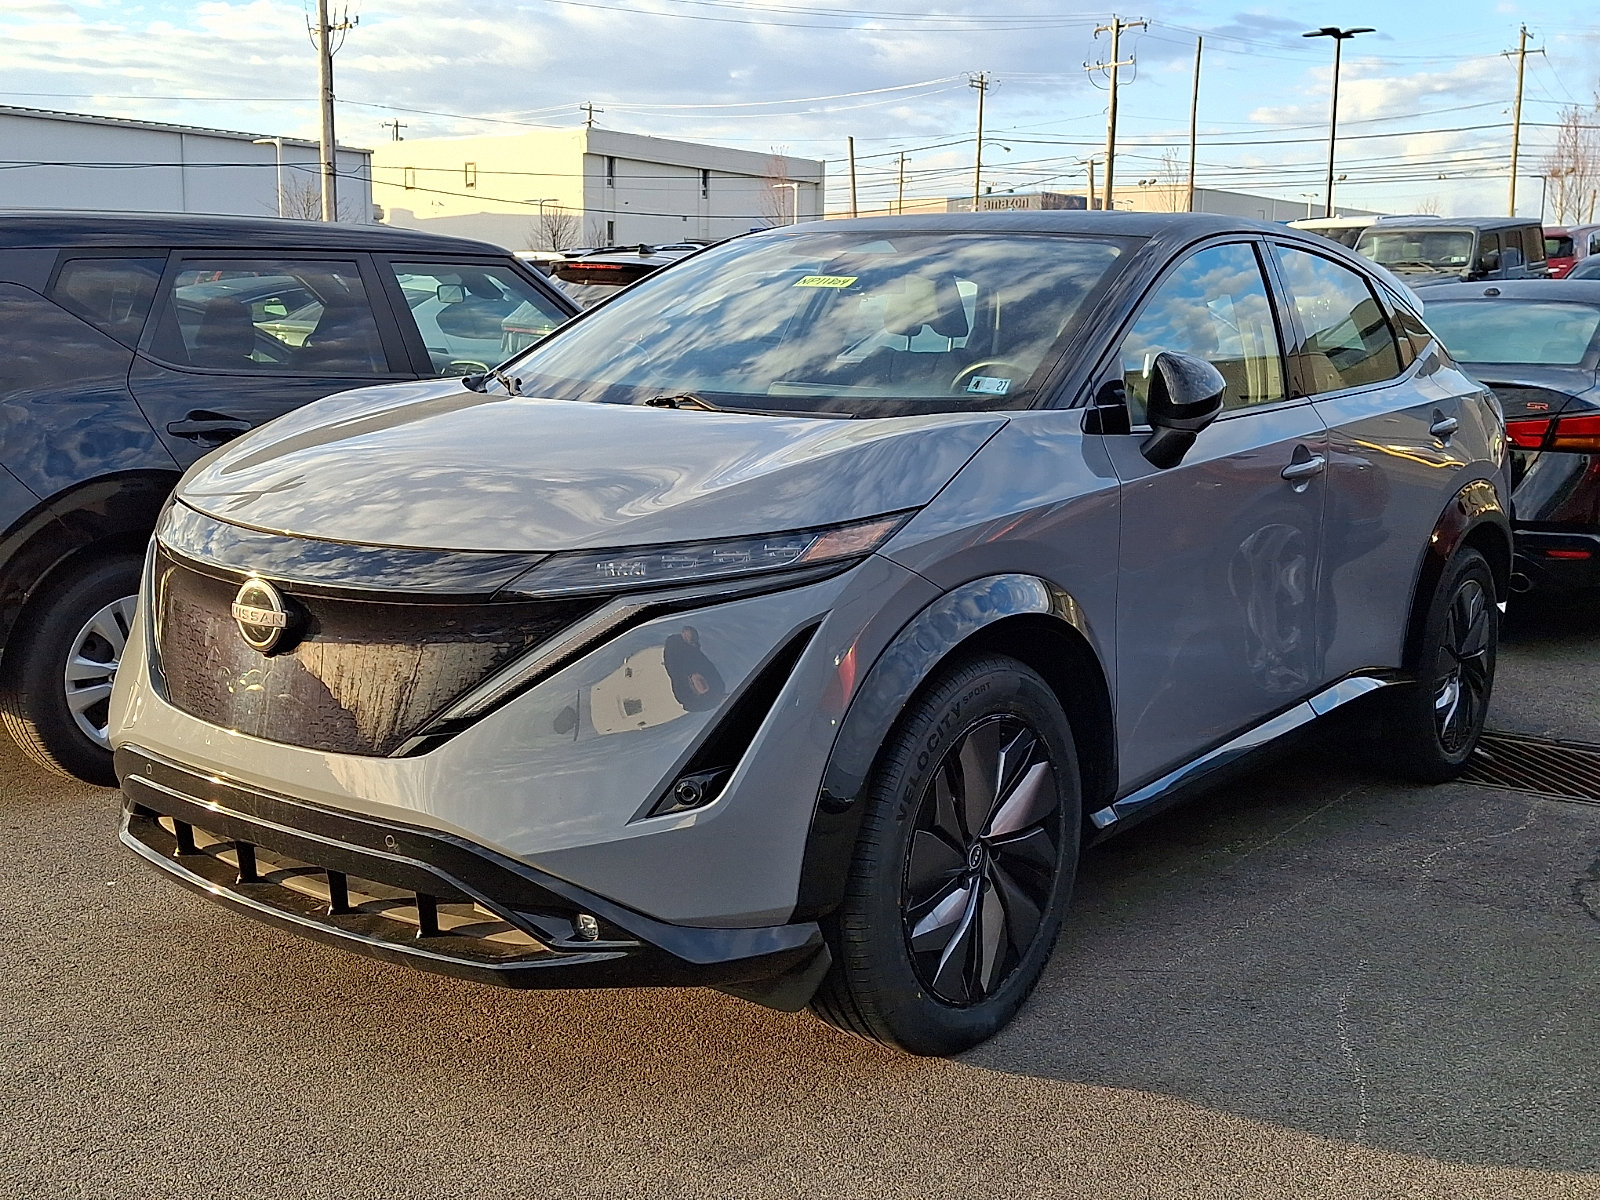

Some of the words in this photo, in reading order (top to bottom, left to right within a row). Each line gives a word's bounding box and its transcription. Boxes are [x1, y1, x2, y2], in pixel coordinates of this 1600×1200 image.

[984, 197, 1029, 210] amazon
[973, 380, 981, 390] 4
[995, 380, 1008, 392] 27
[1526, 401, 1549, 410] SR
[233, 605, 284, 626] NISSAN
[896, 700, 961, 822] VELOCITY
[962, 681, 991, 704] SPORT
